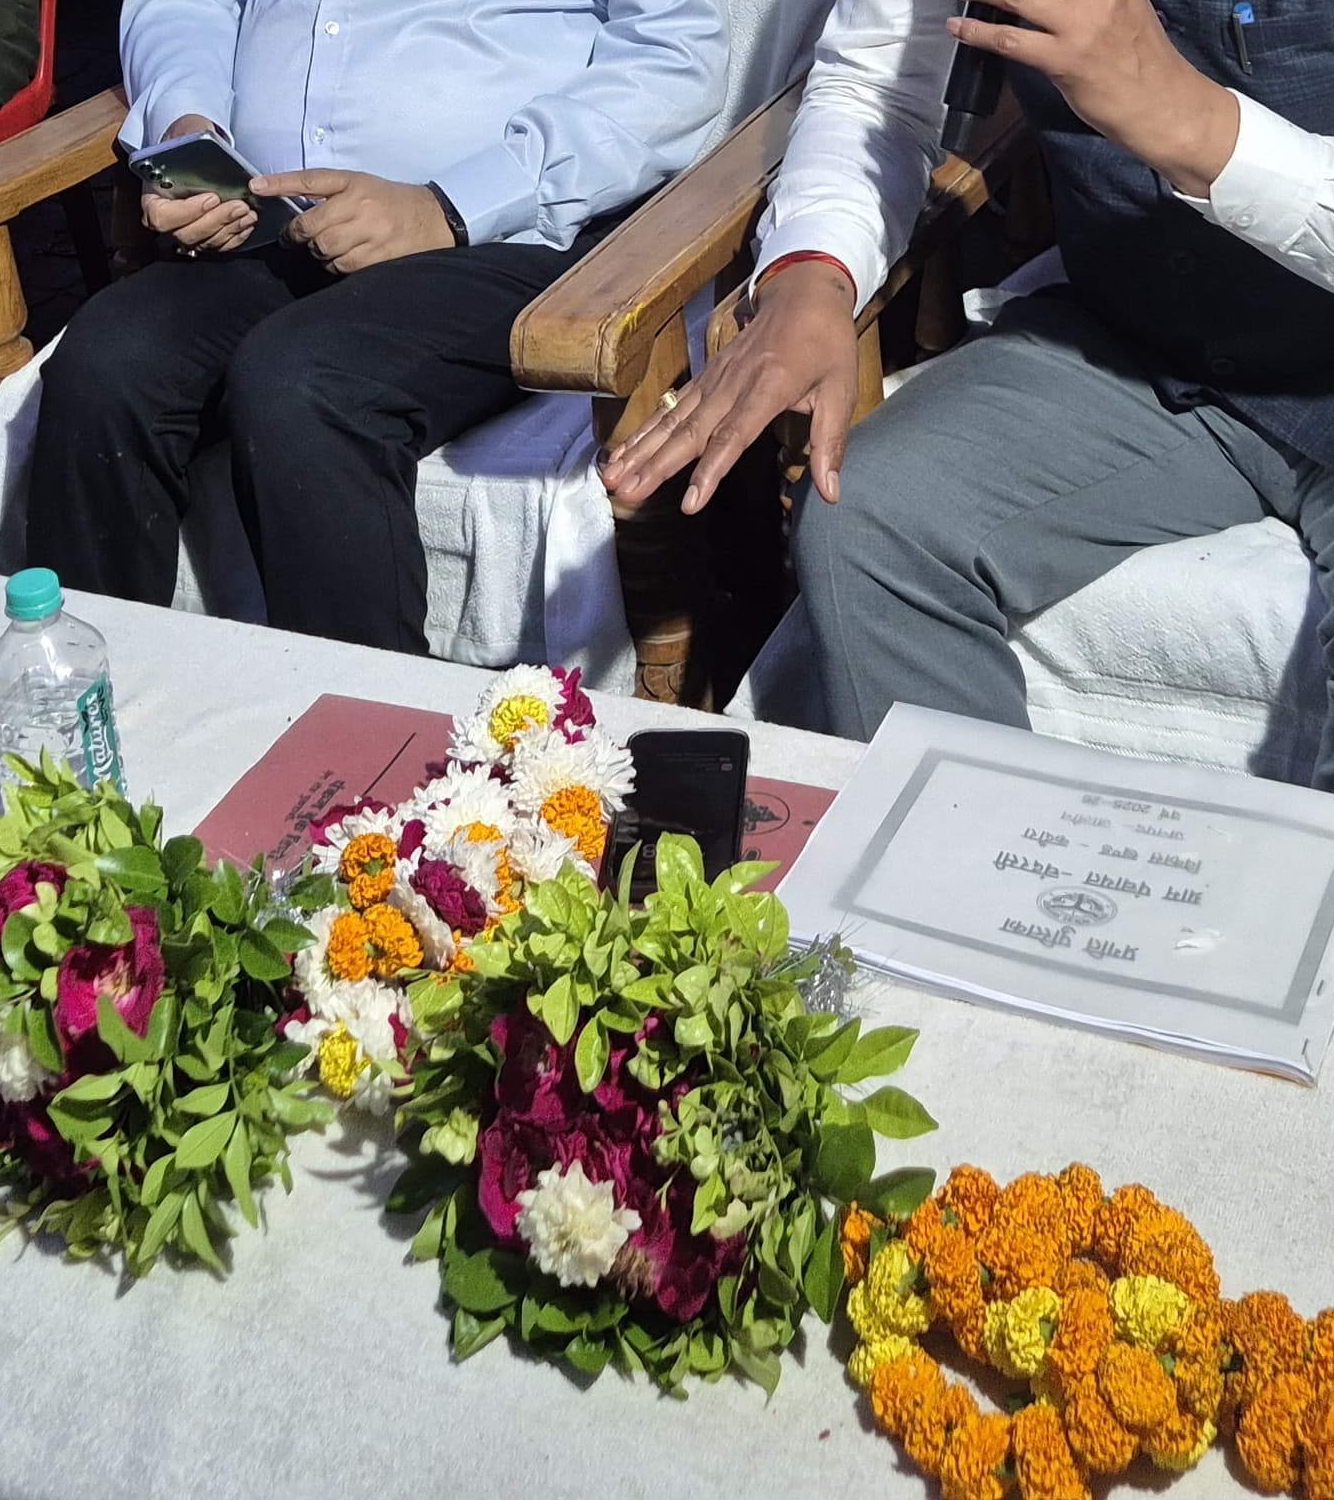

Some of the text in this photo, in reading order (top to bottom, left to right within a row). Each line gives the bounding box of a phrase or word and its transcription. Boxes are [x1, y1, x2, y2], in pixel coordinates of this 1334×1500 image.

[1147, 851, 1203, 875] विकास
[1082, 871, 1152, 899] पंचायत
[1161, 886, 1204, 905] ग्राम
[998, 917, 1077, 948] पुस्तिका
[1082, 936, 1140, 961] प्रगति
